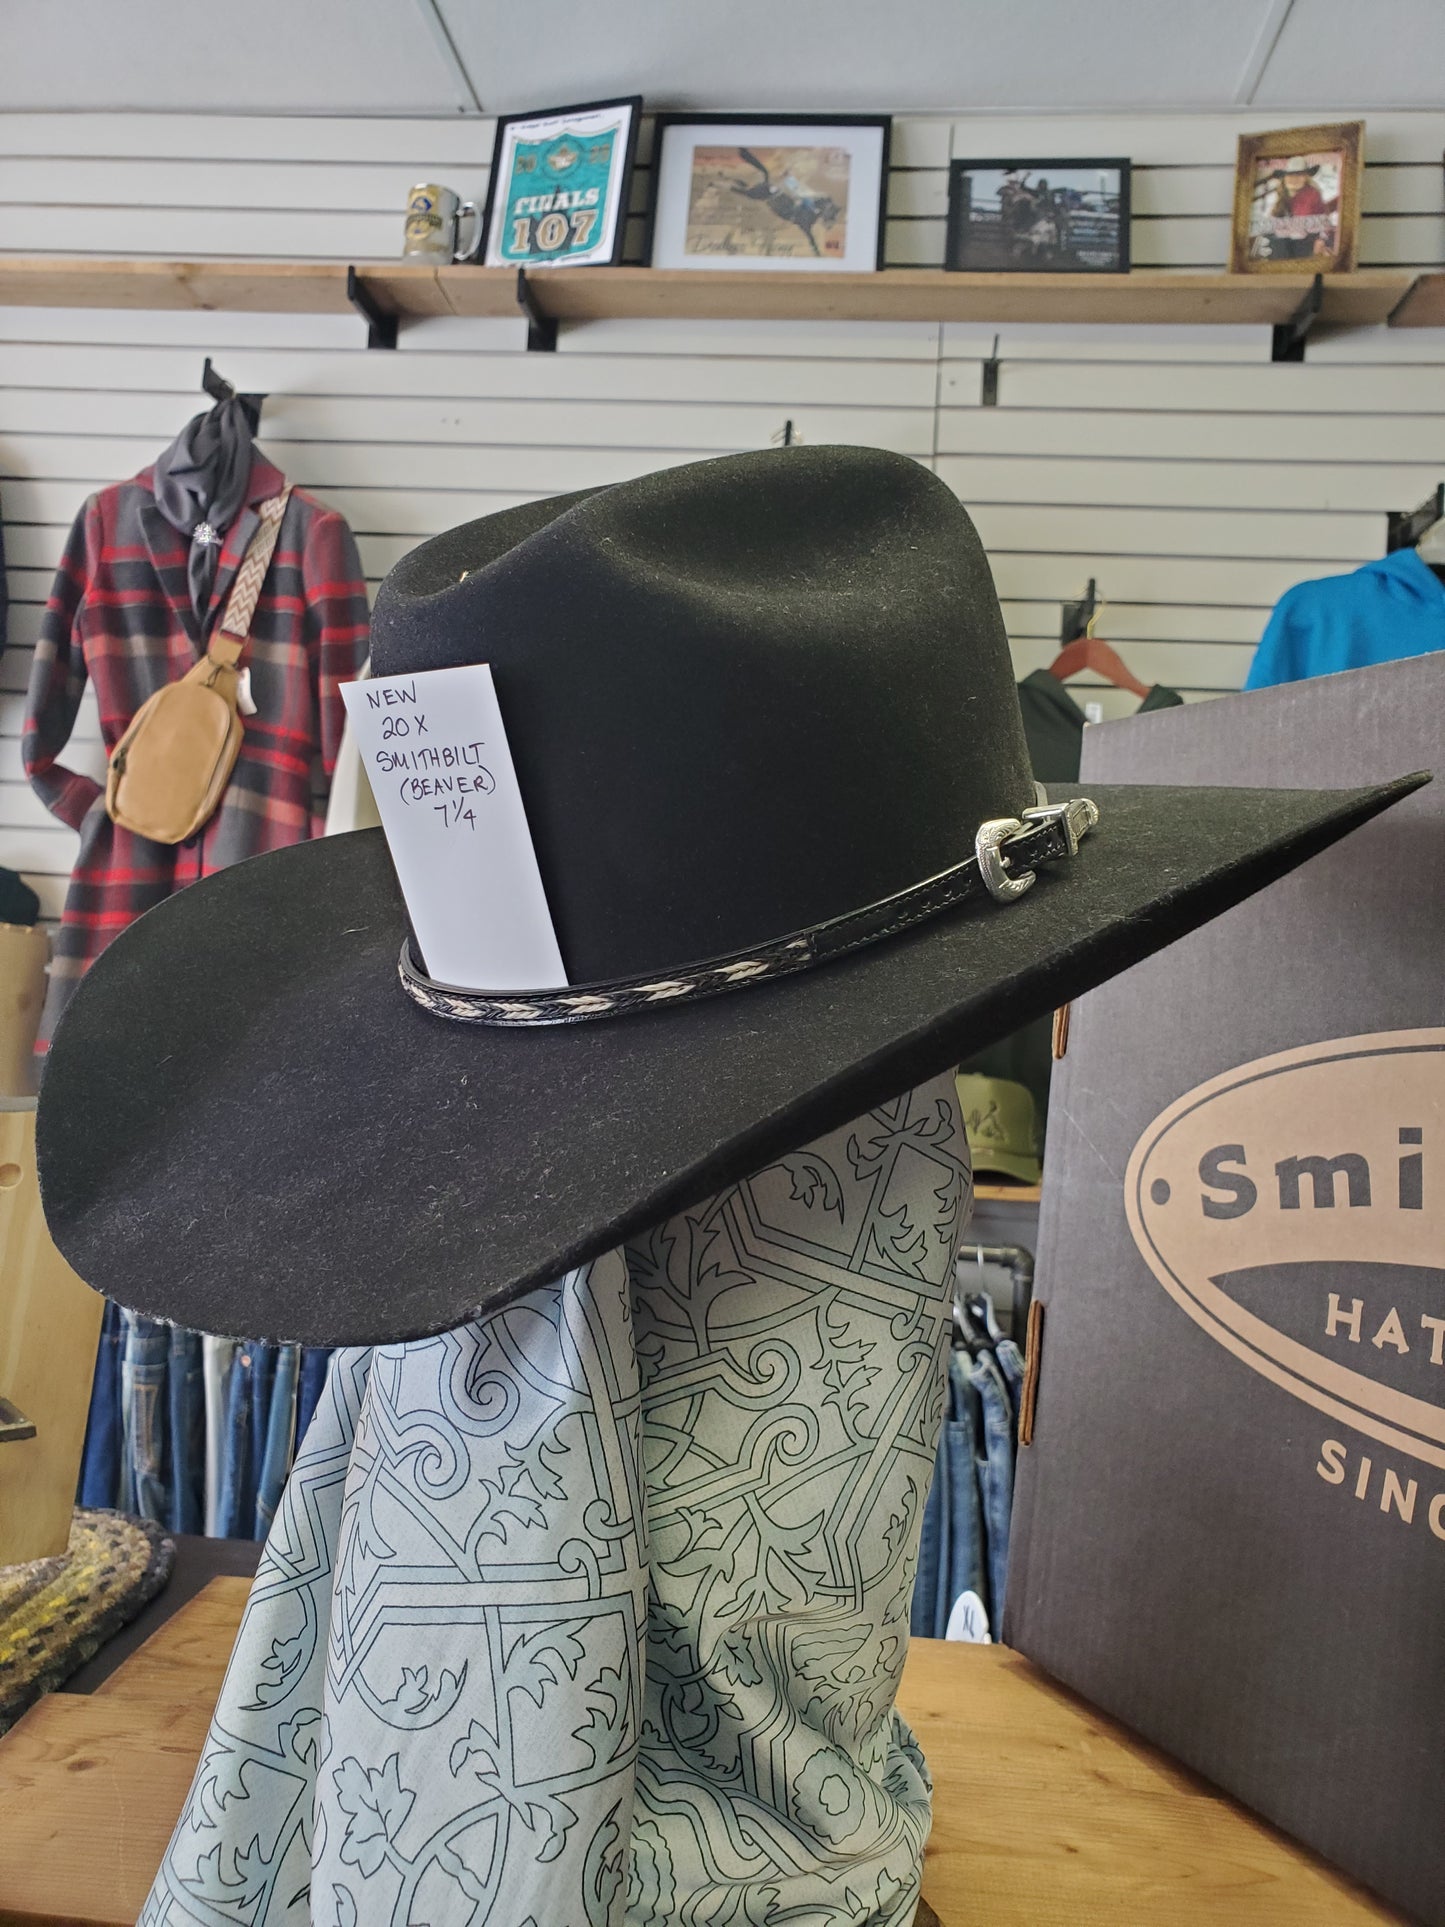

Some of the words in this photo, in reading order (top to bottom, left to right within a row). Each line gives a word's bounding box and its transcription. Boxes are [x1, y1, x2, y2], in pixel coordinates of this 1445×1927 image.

[513, 187, 600, 215] FINALS
[508, 208, 598, 255] 107
[366, 680, 417, 709] NEW
[376, 742, 485, 772] SMITHBILT
[400, 765, 496, 806] (BEAVER)
[1199, 1127, 1423, 1220] Smi
[1325, 1292, 1445, 1366] HAT
[962, 1604, 975, 1639] XL
